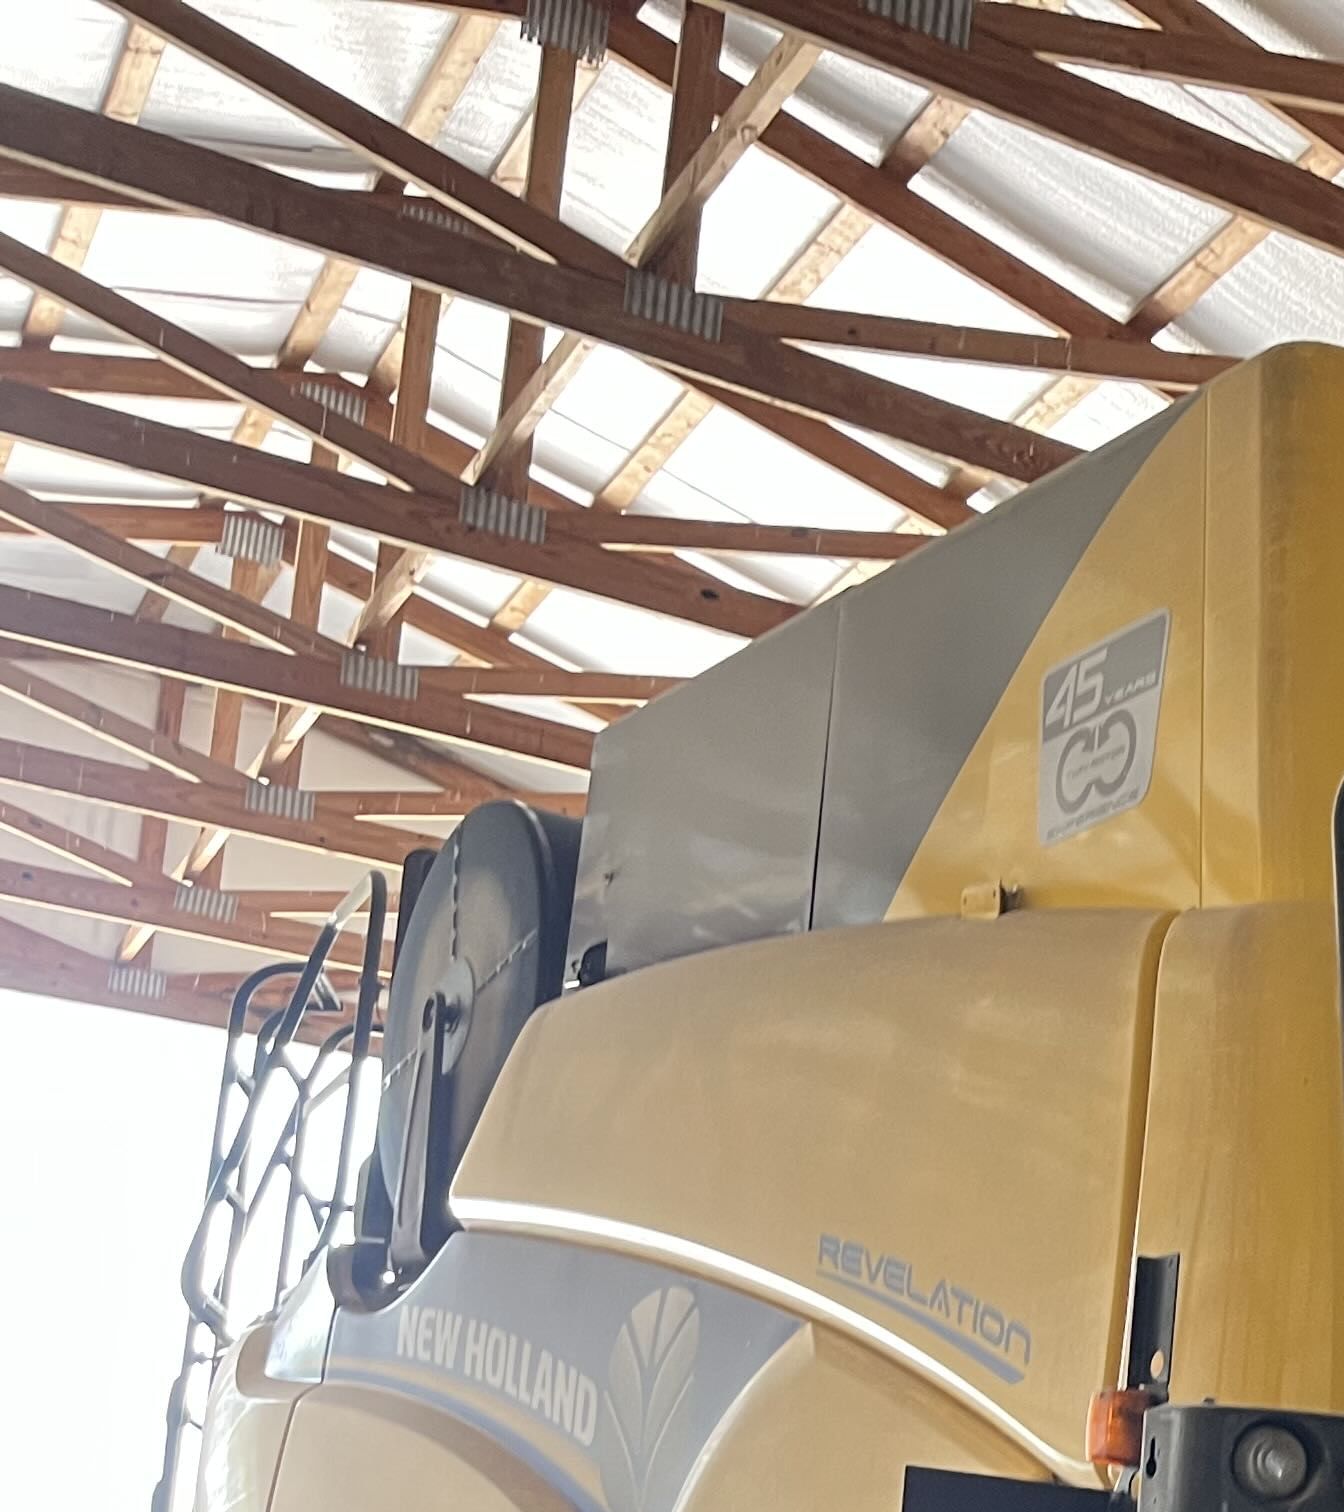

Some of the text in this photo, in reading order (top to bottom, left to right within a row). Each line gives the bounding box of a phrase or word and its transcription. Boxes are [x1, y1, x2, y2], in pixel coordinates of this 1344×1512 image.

[1045, 646, 1108, 729] 45
[1103, 670, 1157, 706] YEARS
[817, 1232, 1033, 1367] REVELATION
[397, 1304, 599, 1447] NEW HOLLAND
